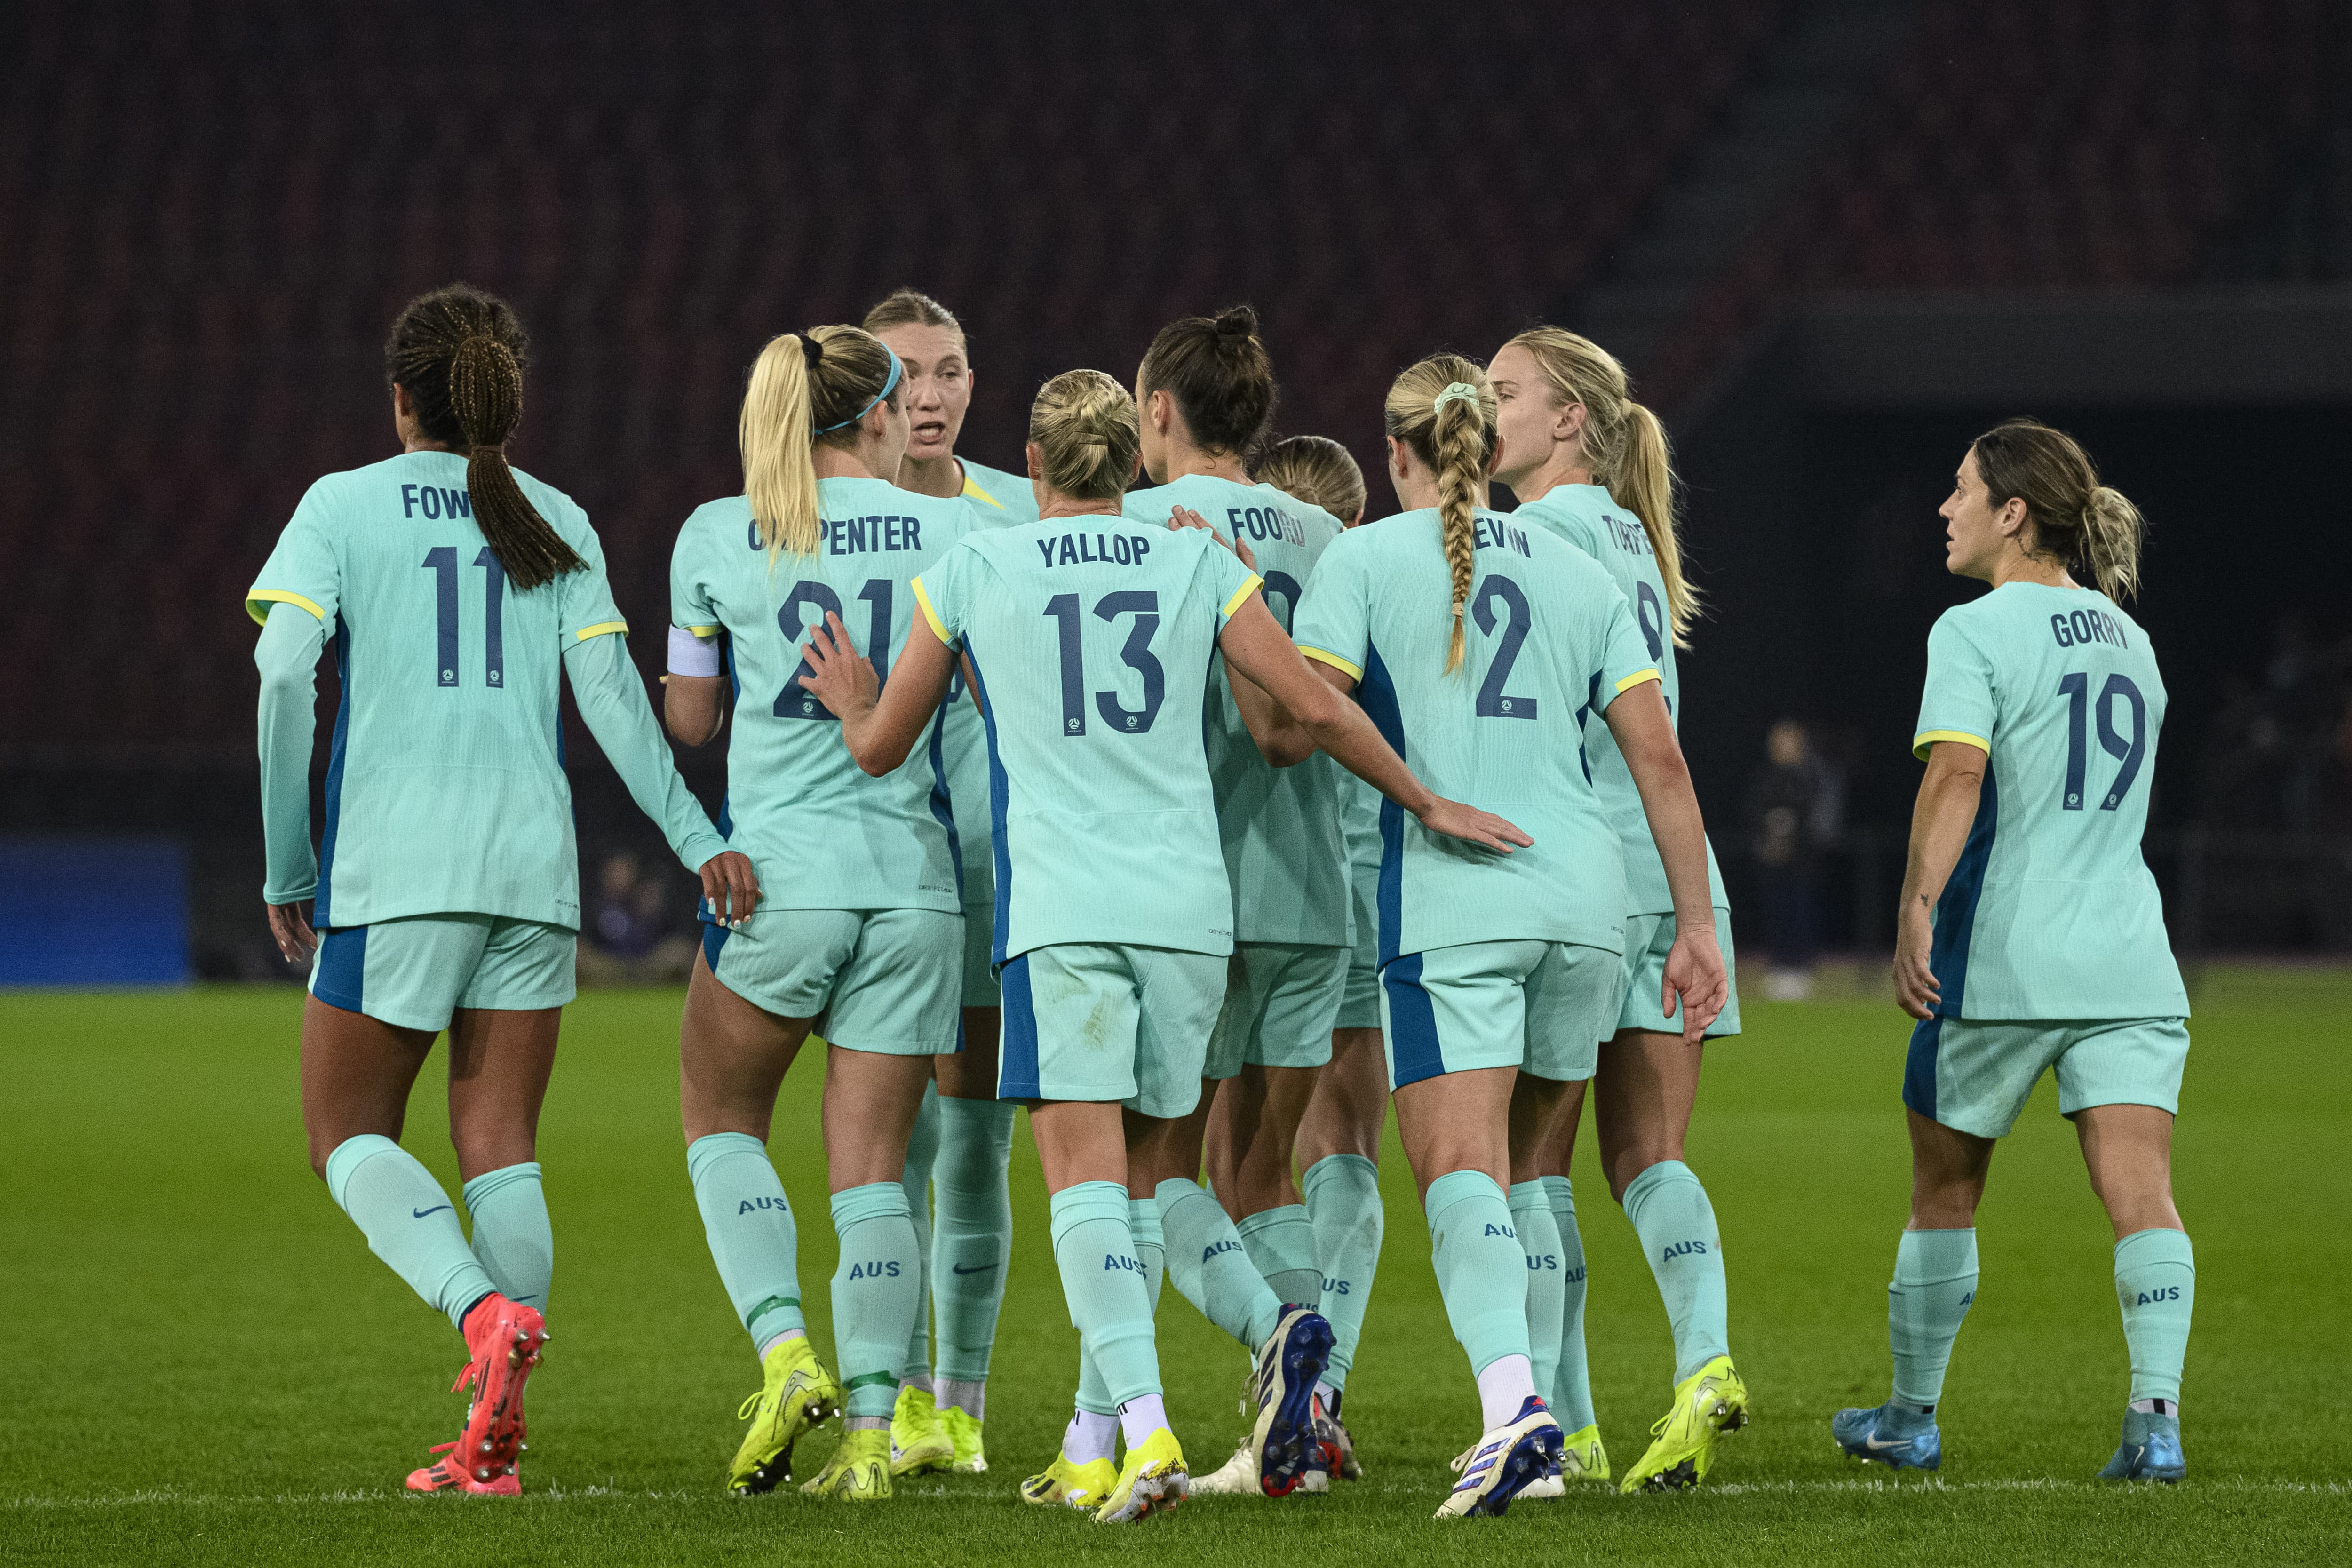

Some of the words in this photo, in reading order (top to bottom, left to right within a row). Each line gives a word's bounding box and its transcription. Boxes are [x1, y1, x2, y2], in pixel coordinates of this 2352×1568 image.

[402, 484, 474, 520] FOW
[748, 516, 922, 555] CPENTER
[1227, 507, 1305, 547] FOORD
[1473, 517, 1531, 558] EVIN
[1037, 533, 1150, 568] YALLOP
[421, 547, 505, 689] 11
[2050, 609, 2127, 650] GORRY
[773, 579, 892, 720] 21
[1043, 591, 1165, 737] 13
[1471, 574, 1537, 720] 2
[2058, 672, 2146, 810] 19
[739, 1197, 787, 1215] AUS
[1485, 1223, 1518, 1239] AU
[1105, 1254, 1143, 1276] AUS
[1202, 1241, 1243, 1263] AUS
[1526, 1255, 1557, 1270] US
[1663, 1240, 1707, 1262] AUS
[850, 1261, 900, 1280] AUS
[1322, 1278, 1351, 1295] US
[1565, 1266, 1586, 1286] AU
[2137, 1287, 2180, 1306] AUS
